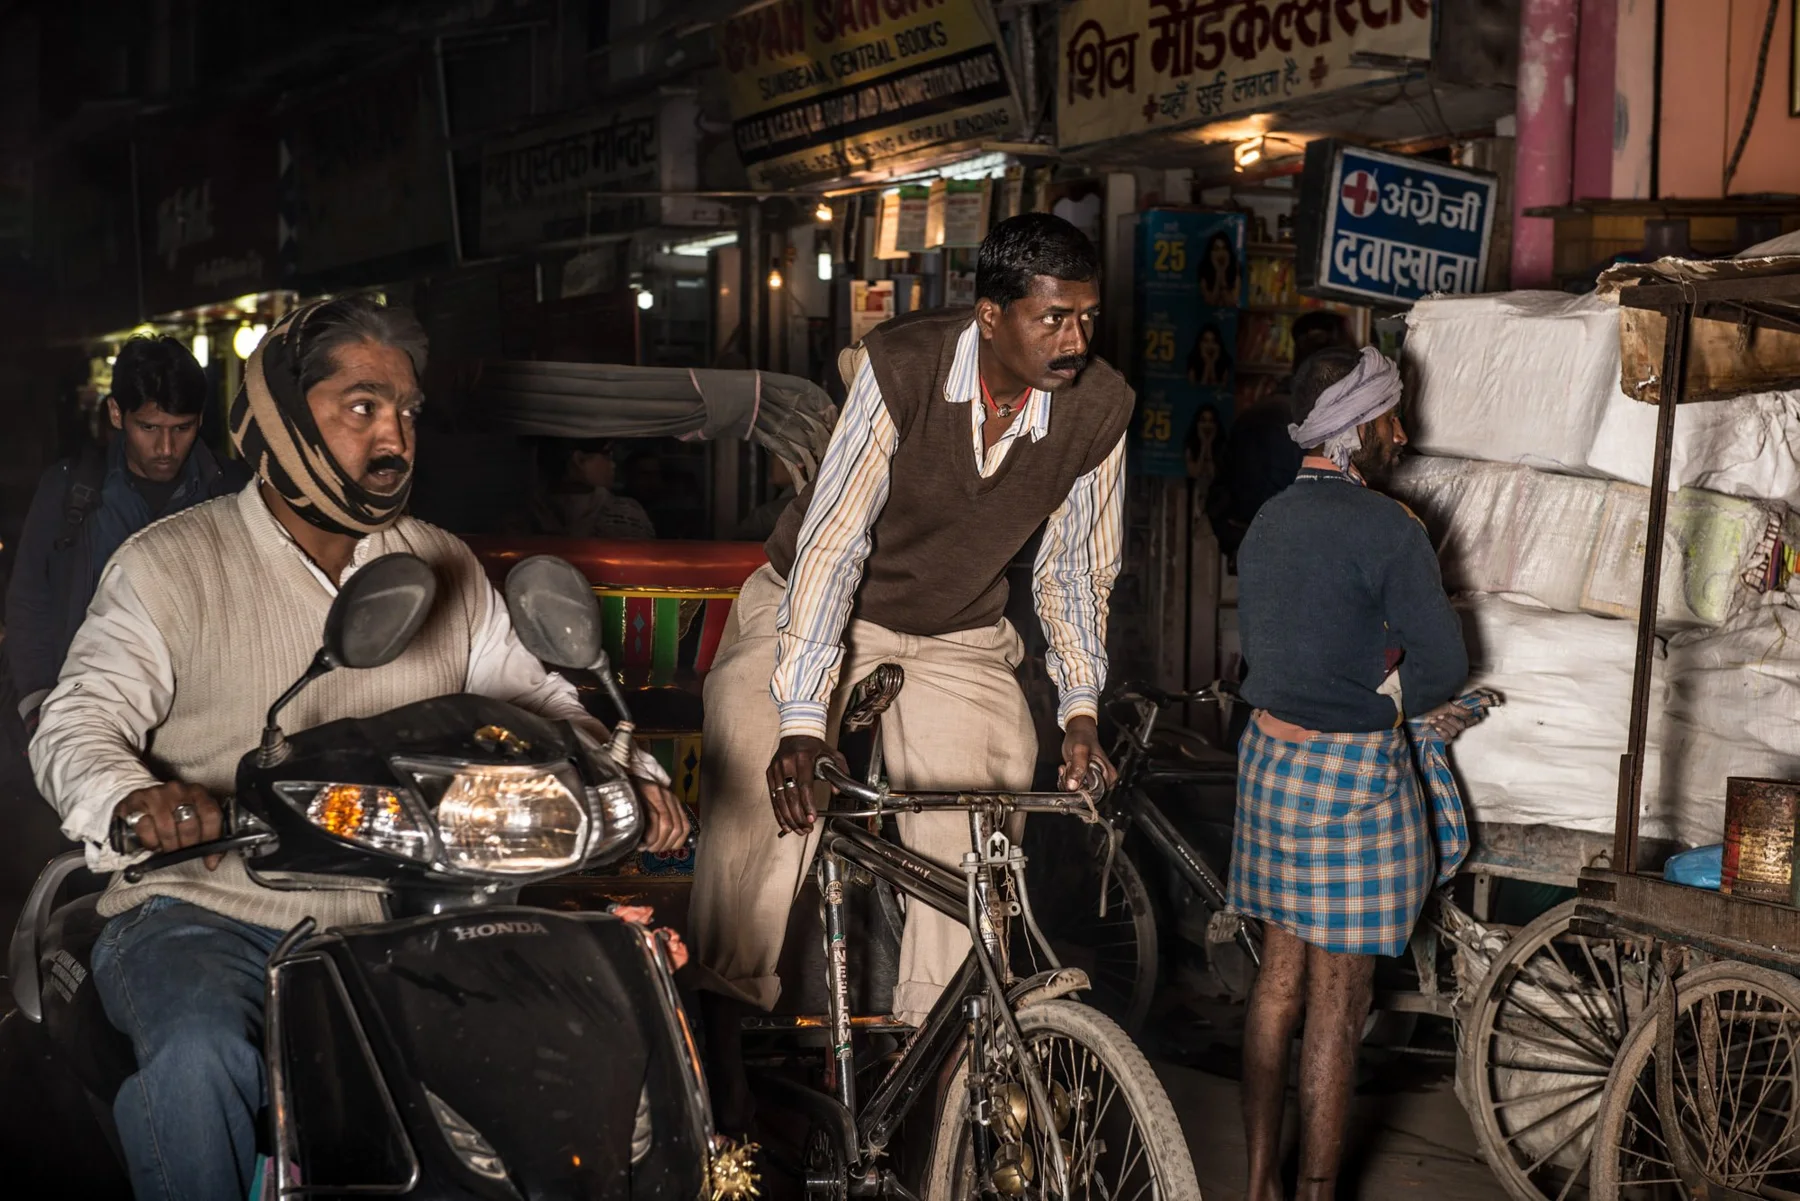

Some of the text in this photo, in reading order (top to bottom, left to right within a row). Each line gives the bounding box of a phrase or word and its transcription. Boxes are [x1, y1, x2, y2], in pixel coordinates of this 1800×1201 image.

[814, 0, 945, 43] SAN
[832, 39, 896, 78] CENTRAL
[895, 21, 948, 57] BOOKS
[1067, 20, 1139, 105] शिव
[1381, 177, 1482, 232] अंग्रेजी
[1153, 239, 1187, 273] 25
[1334, 229, 1478, 294] दवाखाना
[1144, 329, 1176, 363] 25
[1140, 408, 1172, 442] 25
[452, 921, 550, 942] HONDA
[833, 949, 852, 1042] NEELAM
